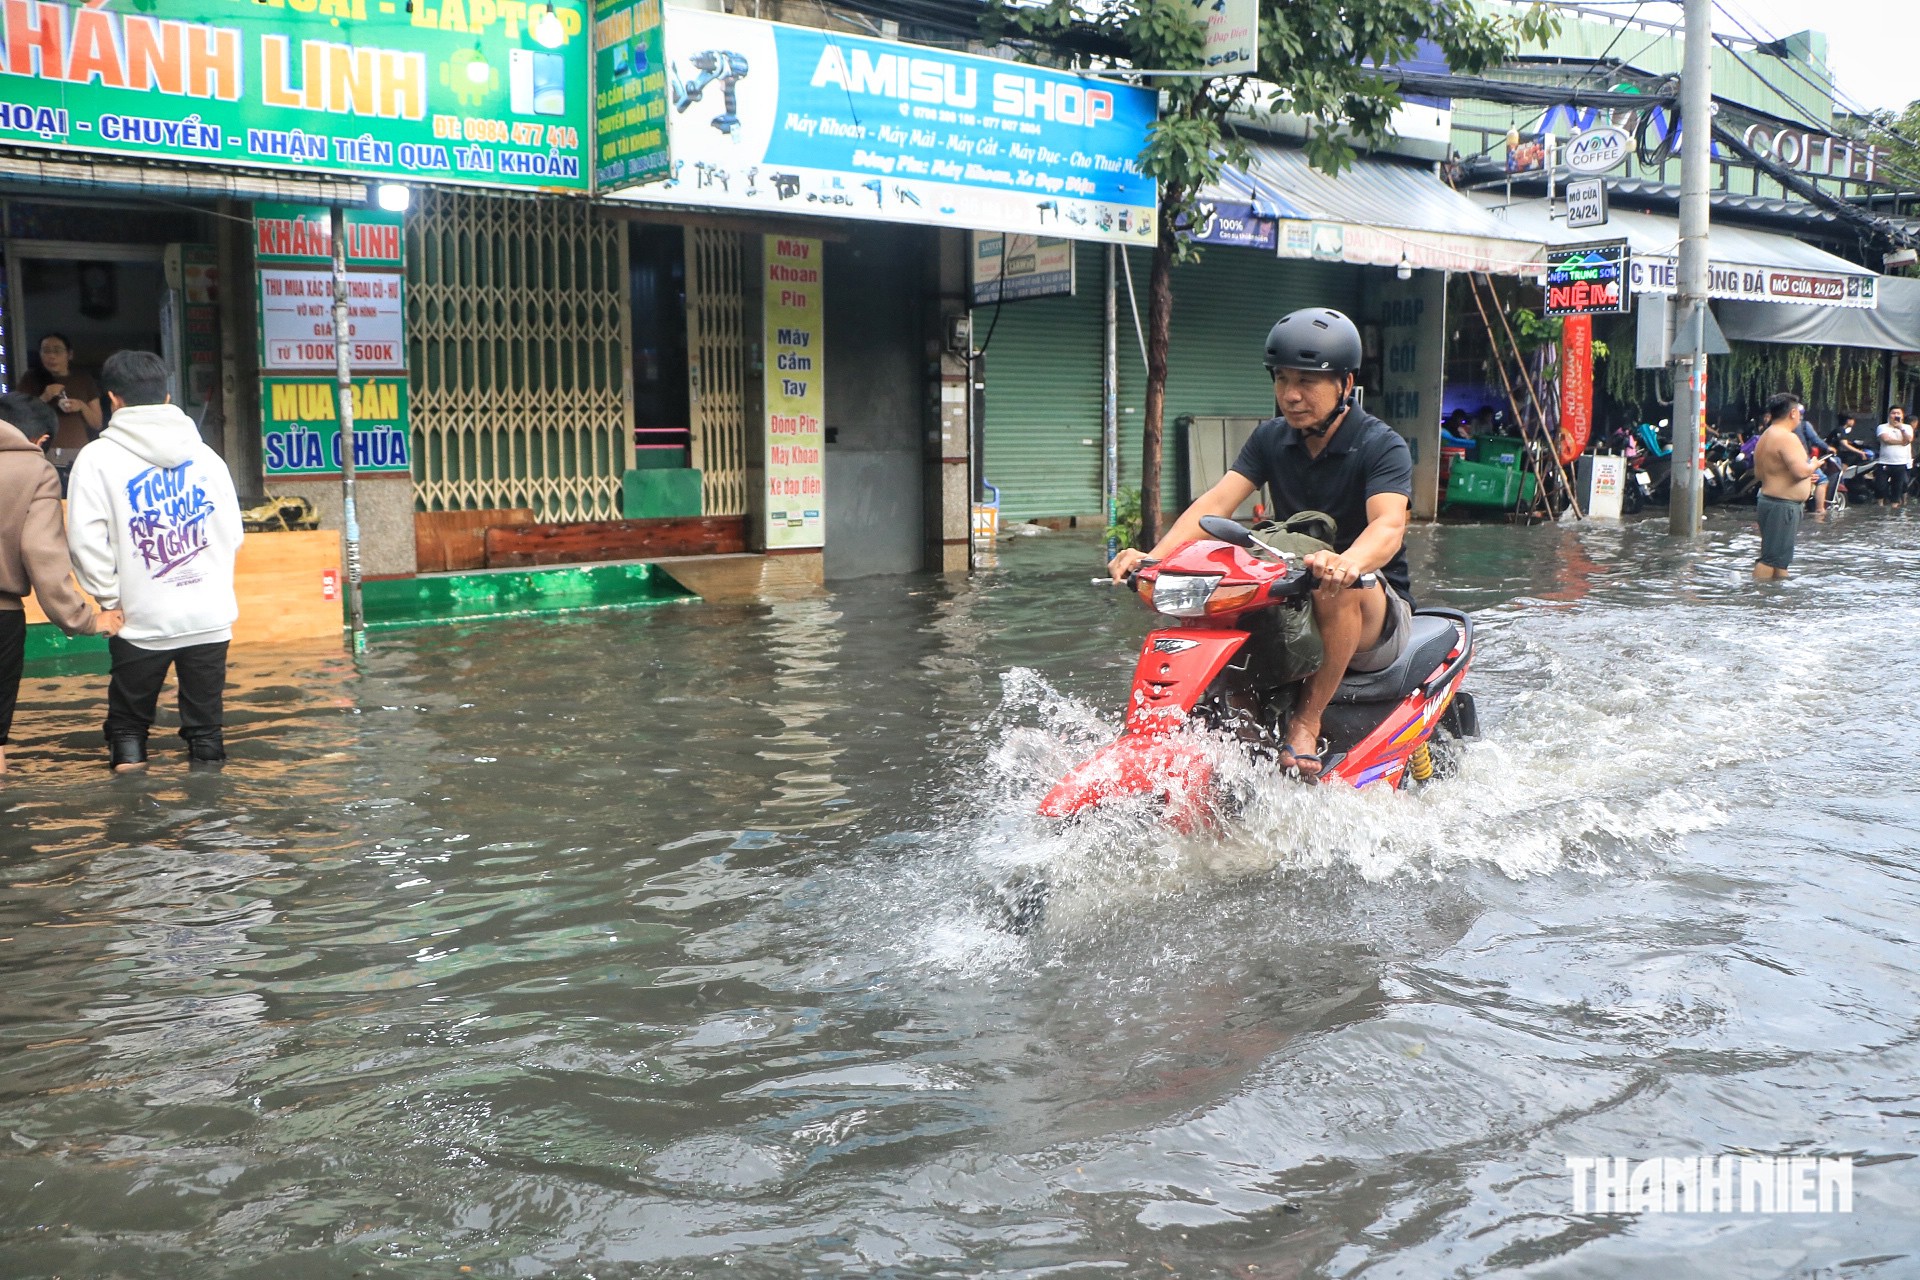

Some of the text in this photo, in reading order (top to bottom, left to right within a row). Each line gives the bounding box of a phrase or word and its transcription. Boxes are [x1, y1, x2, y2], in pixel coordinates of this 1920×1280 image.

[0, 0, 426, 120] HÁNH LINH
[810, 45, 1113, 128] AMISU SHOP
[433, 114, 579, 149] ĐT: 0984 477 414
[100, 114, 221, 150] CHUYỂN
[248, 128, 328, 163] NHẬN
[335, 133, 393, 165] TIỀN
[399, 143, 450, 170] QUA
[456, 145, 493, 172] TÀI
[500, 149, 580, 179] KHOẢN
[785, 113, 817, 137] Máy
[819, 117, 866, 139] Khoan
[878, 124, 908, 148] Máy
[909, 128, 936, 148] Mài
[946, 133, 973, 157] Máy
[1009, 142, 1035, 164] Máy
[1037, 146, 1060, 167] Đục
[1070, 151, 1092, 169] Cho
[1095, 154, 1122, 173] Thuê
[1572, 149, 1619, 165] COFFEE
[1744, 124, 1895, 184] COFFEE
[1583, 189, 1598, 201] CỬA
[1569, 207, 1598, 220] 24/24
[1219, 218, 1244, 231] 100%
[348, 223, 399, 259] LINH
[777, 239, 809, 259] Máy
[769, 264, 818, 282] Khoan
[1569, 268, 1599, 280] TRUNG
[1649, 261, 1676, 287] TIẾ
[1707, 265, 1738, 291] ÓNG
[266, 279, 282, 296] THU
[285, 280, 304, 296] MUA
[307, 277, 323, 297] XÁC
[348, 281, 371, 299] THOẠI
[1550, 280, 1618, 310] NỆM
[1773, 276, 1842, 297] MỞ CỬA 24/24
[781, 290, 806, 307] Pin
[314, 322, 332, 336] GIÁ
[777, 328, 810, 347] Máy
[296, 344, 335, 360] 100K
[355, 344, 393, 360] 500K
[782, 379, 807, 397] Tay
[271, 377, 399, 421] MUA BÁN
[771, 414, 818, 435] Đóng Pin:
[266, 423, 325, 470] SỬA
[771, 445, 818, 466] Máy Khoan
[125, 460, 193, 513] FIGHT
[770, 477, 782, 496] Xe
[128, 484, 213, 546] FOR YOUR
[139, 505, 215, 569] RIGHT!
[1385, 764, 1405, 776] HONDA
